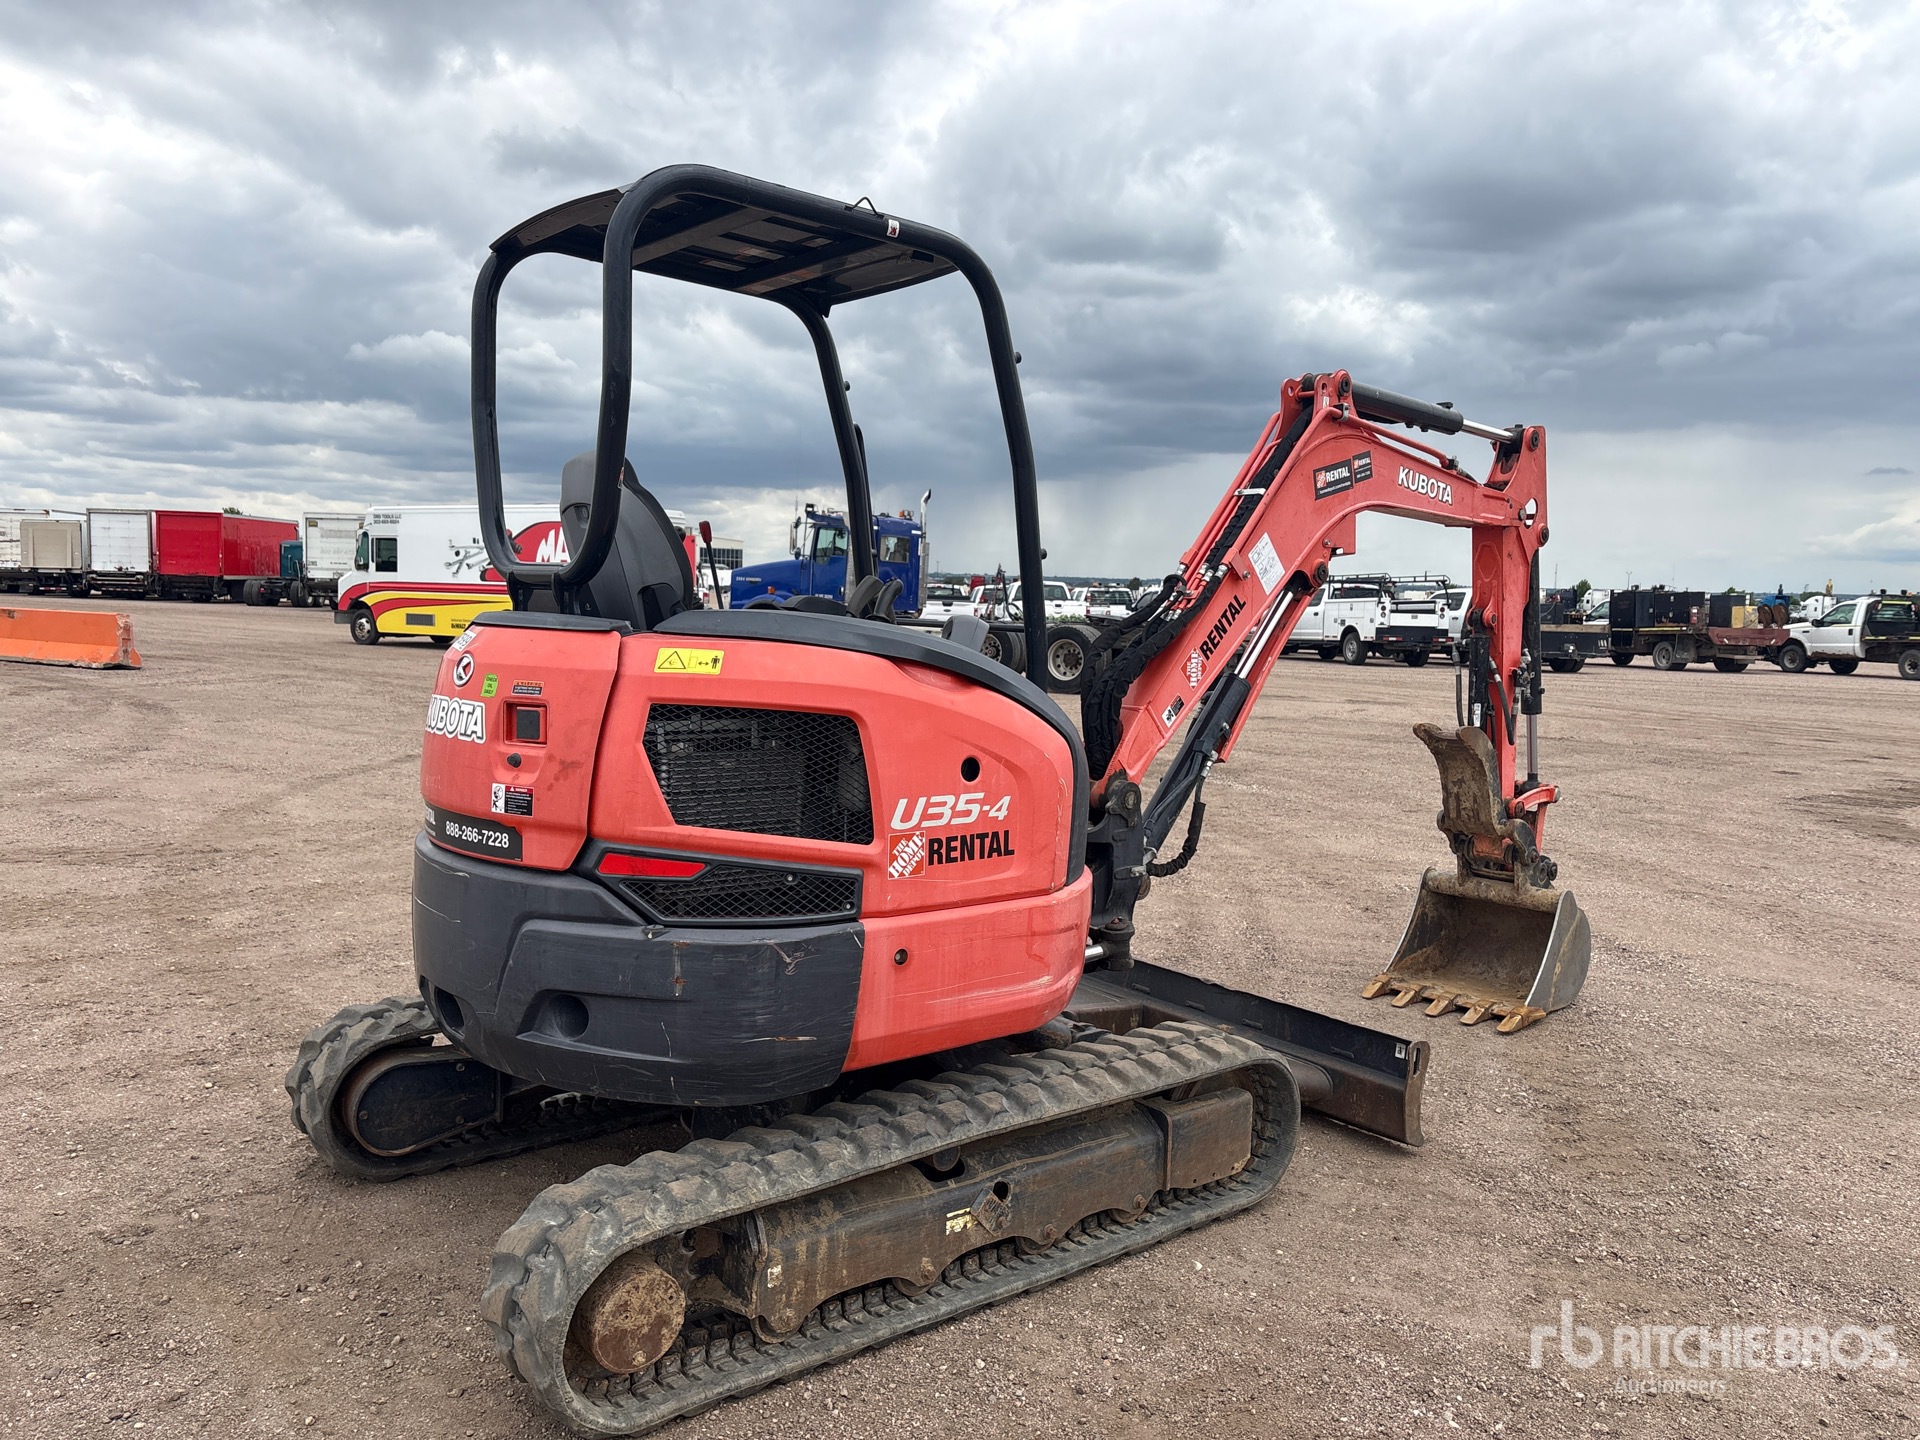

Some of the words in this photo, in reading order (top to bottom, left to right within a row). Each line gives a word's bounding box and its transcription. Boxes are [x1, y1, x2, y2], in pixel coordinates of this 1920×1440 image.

[1325, 466, 1350, 483] RENTAL
[1398, 464, 1453, 506] KUBOTA
[1199, 594, 1247, 661] RENTAL
[890, 792, 1012, 830] U35-4
[446, 820, 509, 848] 888-266-7228
[892, 837, 909, 857] THE
[928, 830, 1015, 866] RENTAL
[888, 832, 925, 879] HOME
[902, 847, 925, 877] DEPOT
